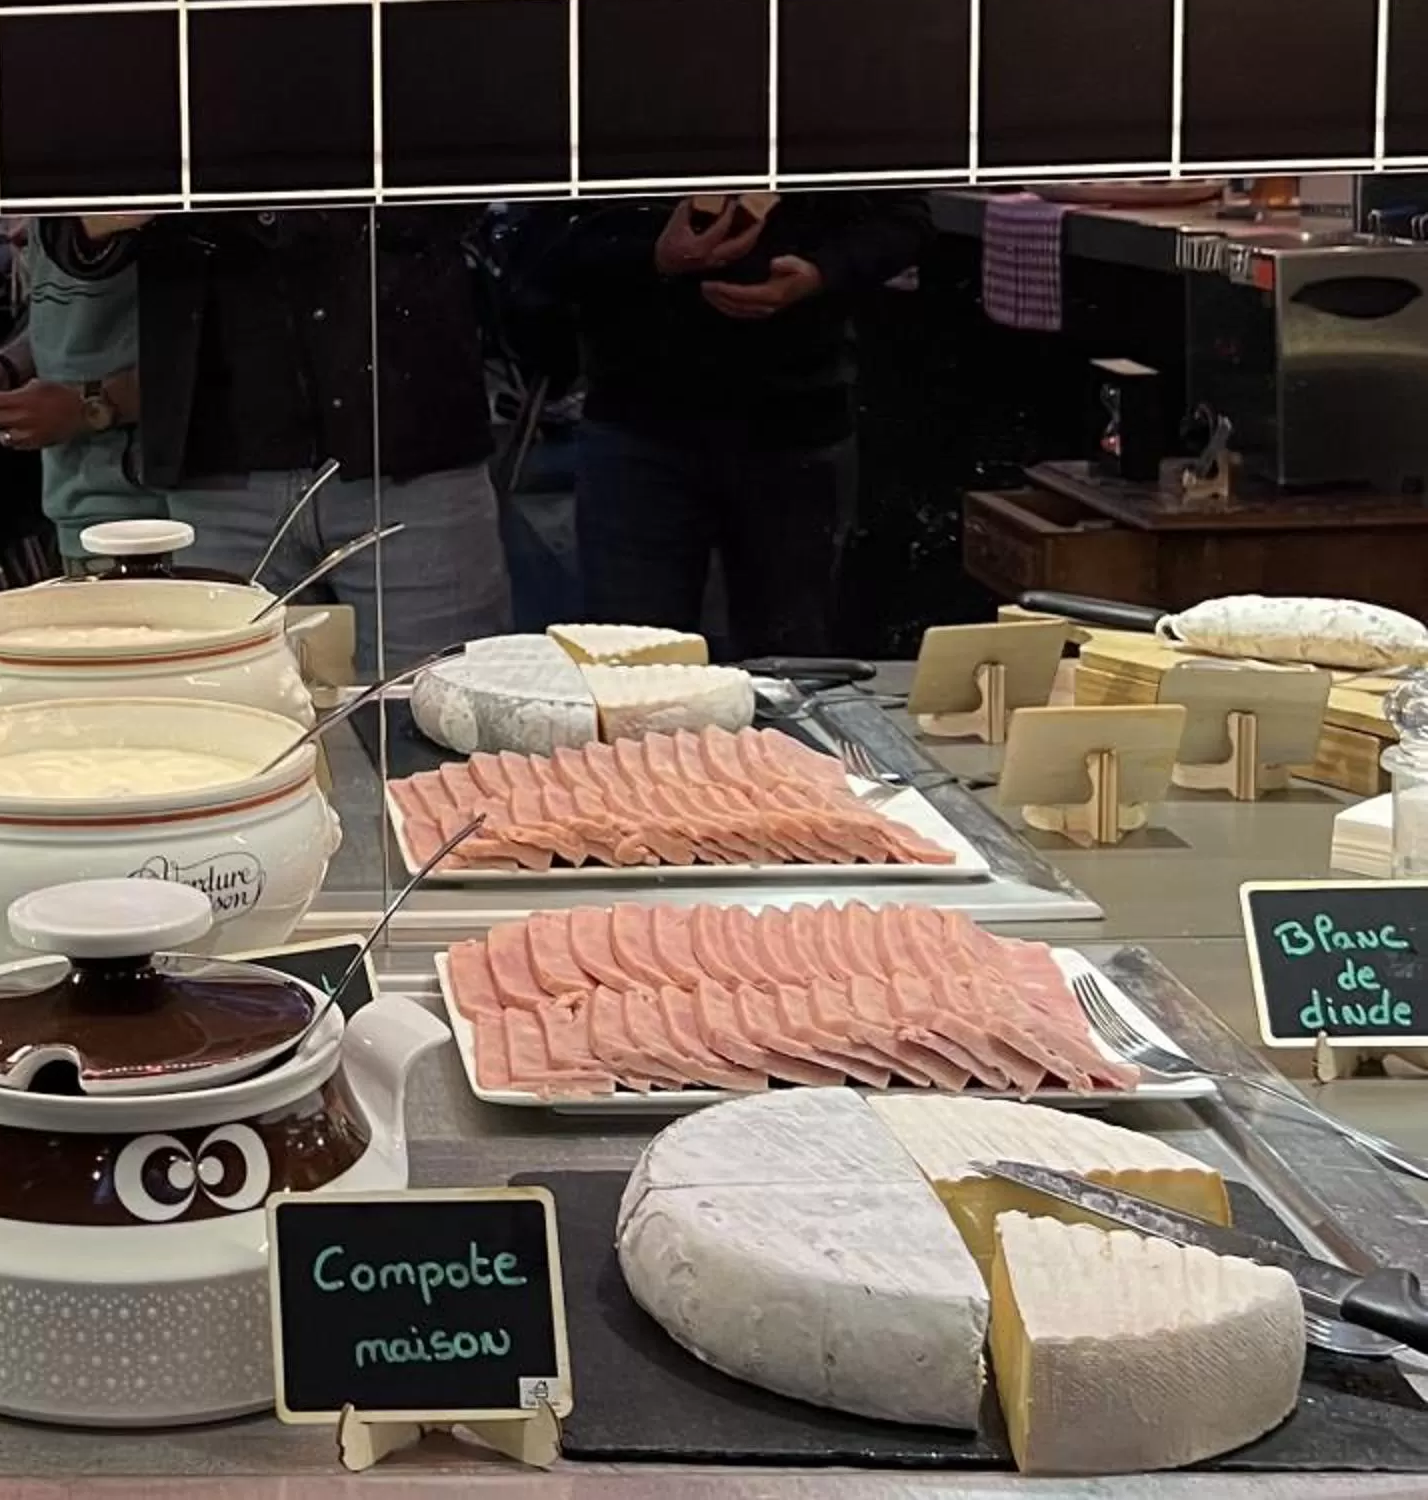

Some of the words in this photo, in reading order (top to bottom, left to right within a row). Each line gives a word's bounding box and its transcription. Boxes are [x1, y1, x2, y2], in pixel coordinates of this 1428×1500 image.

[1273, 913, 1409, 956] Blanc
[1337, 957, 1381, 991] de
[1299, 988, 1413, 1029] dinde
[313, 1240, 528, 1306] Compote
[355, 1325, 511, 1368] maison
